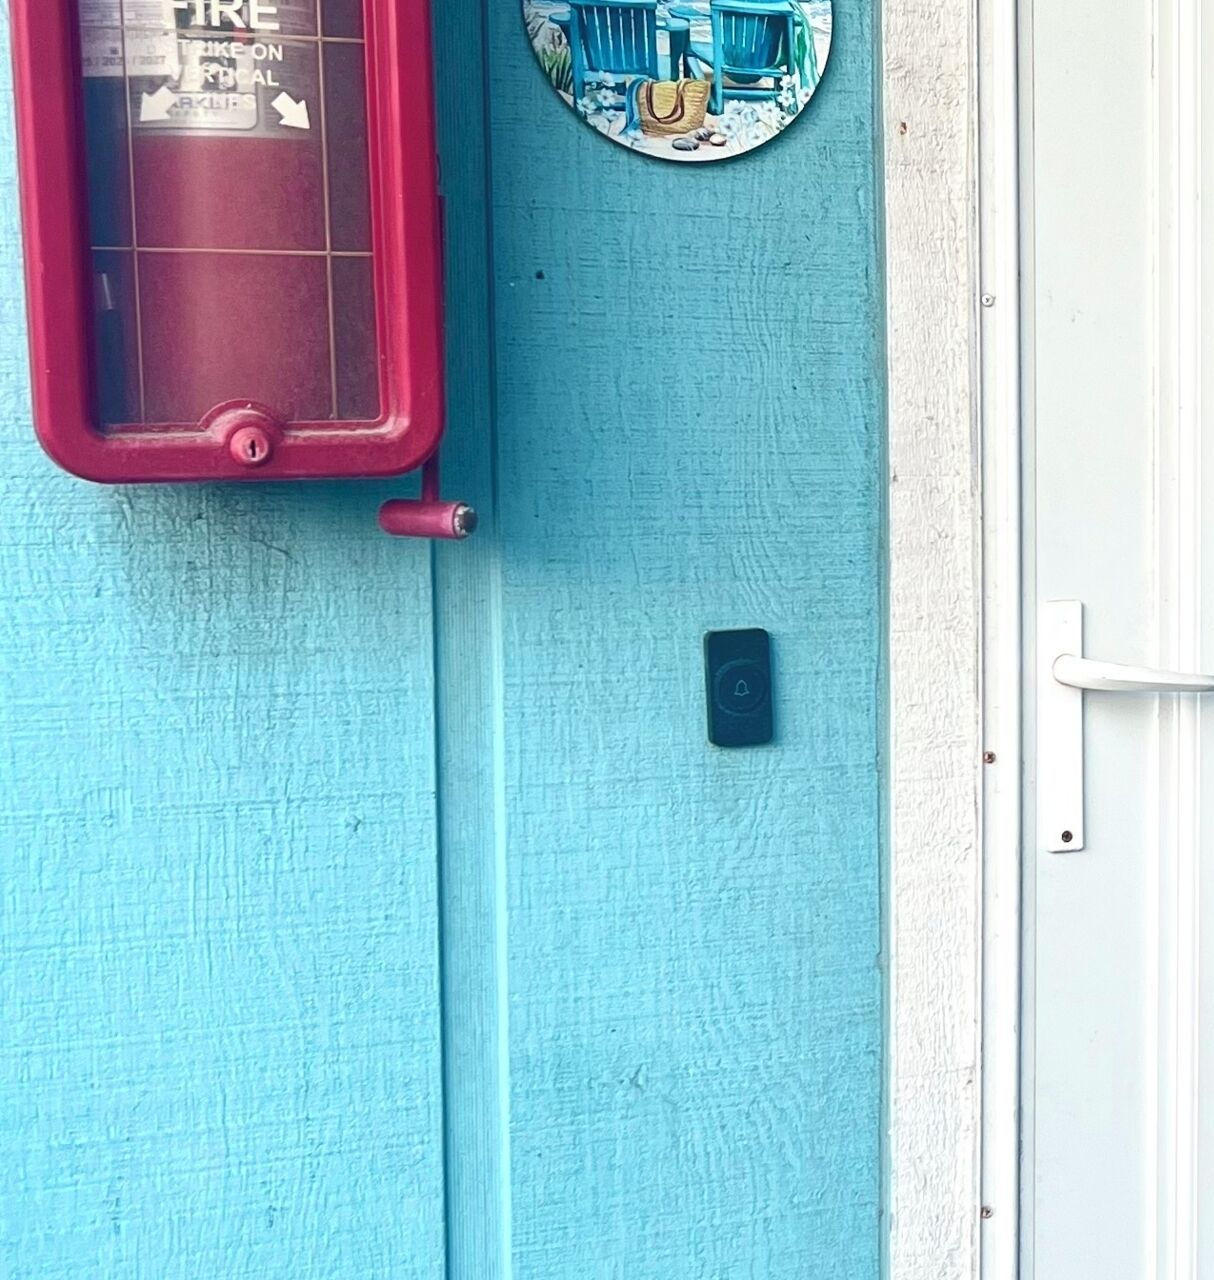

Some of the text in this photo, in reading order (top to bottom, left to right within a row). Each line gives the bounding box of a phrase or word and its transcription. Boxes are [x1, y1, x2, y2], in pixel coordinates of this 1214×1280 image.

[174, 39, 283, 62] TRIKE ON
[171, 64, 280, 87] ERTICAL
